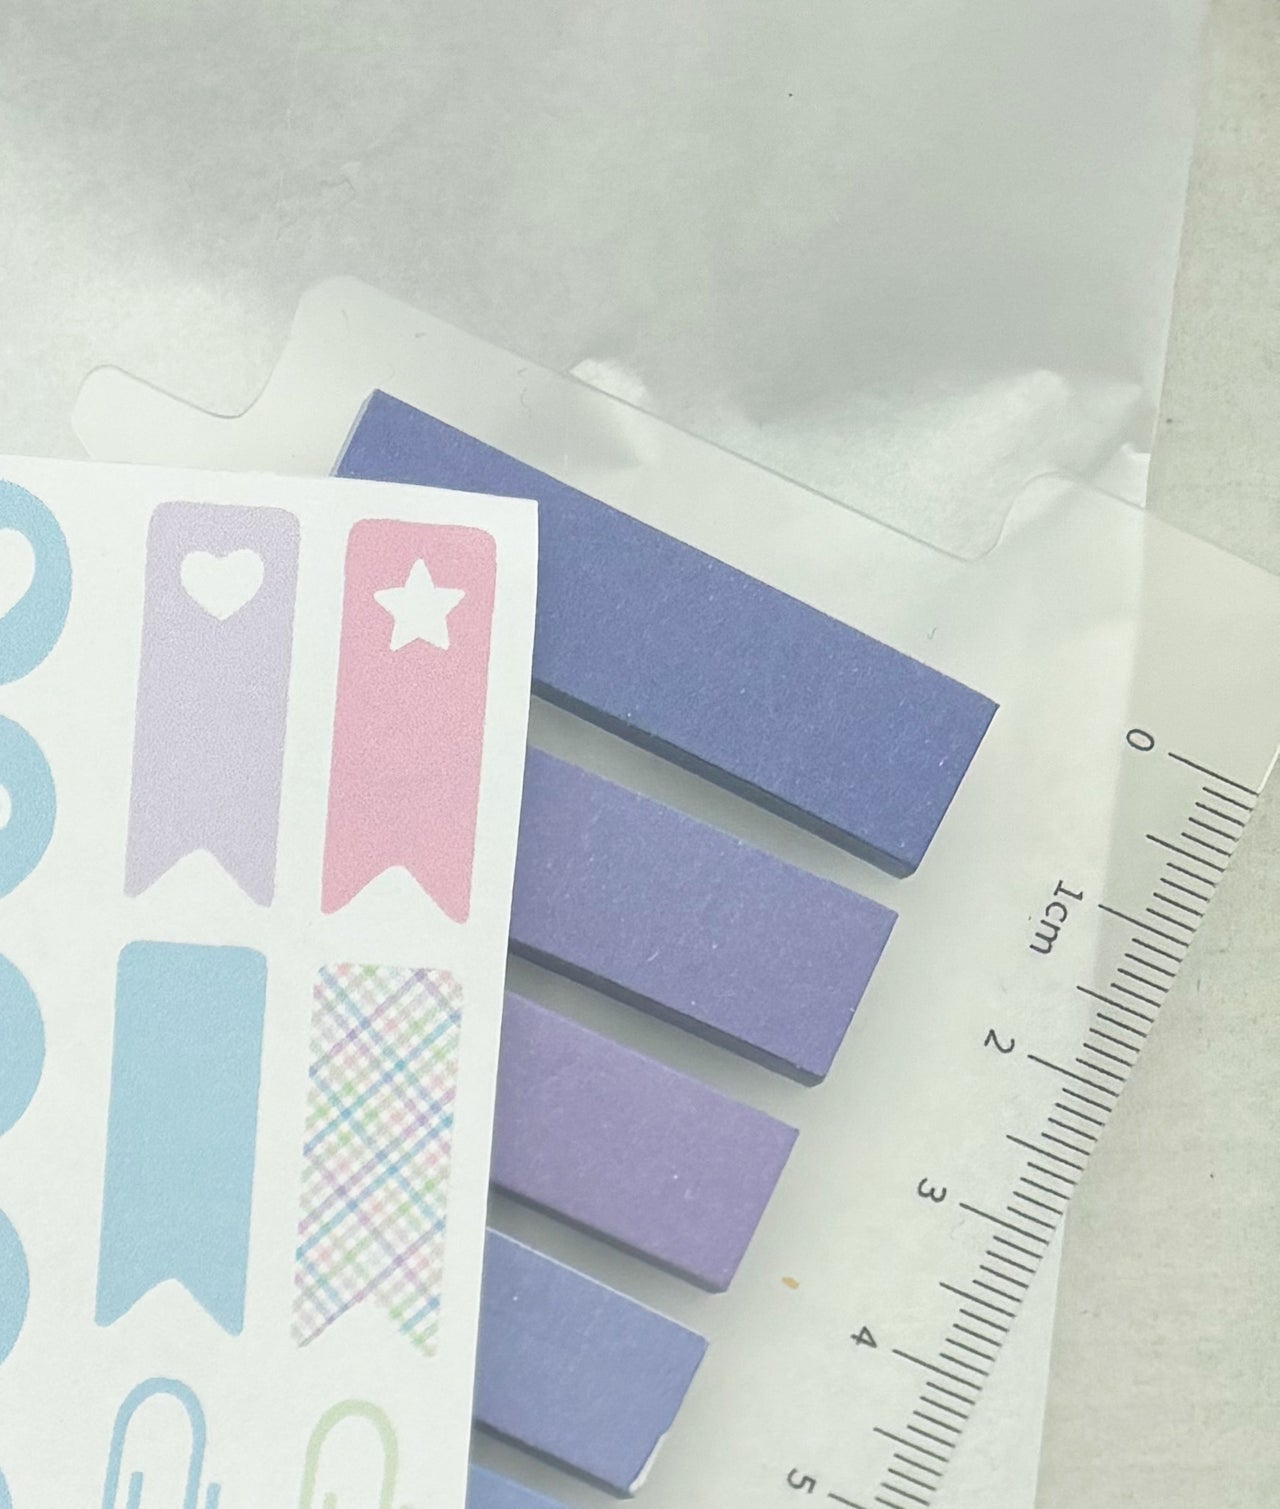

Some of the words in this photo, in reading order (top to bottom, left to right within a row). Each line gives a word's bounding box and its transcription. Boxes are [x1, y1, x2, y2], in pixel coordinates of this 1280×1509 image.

[1028, 879, 1084, 956] 1cm
[983, 1028, 1016, 1055] 2
[917, 1177, 948, 1204] 3
[850, 1325, 878, 1350] 4
[786, 1467, 817, 1494] 5
